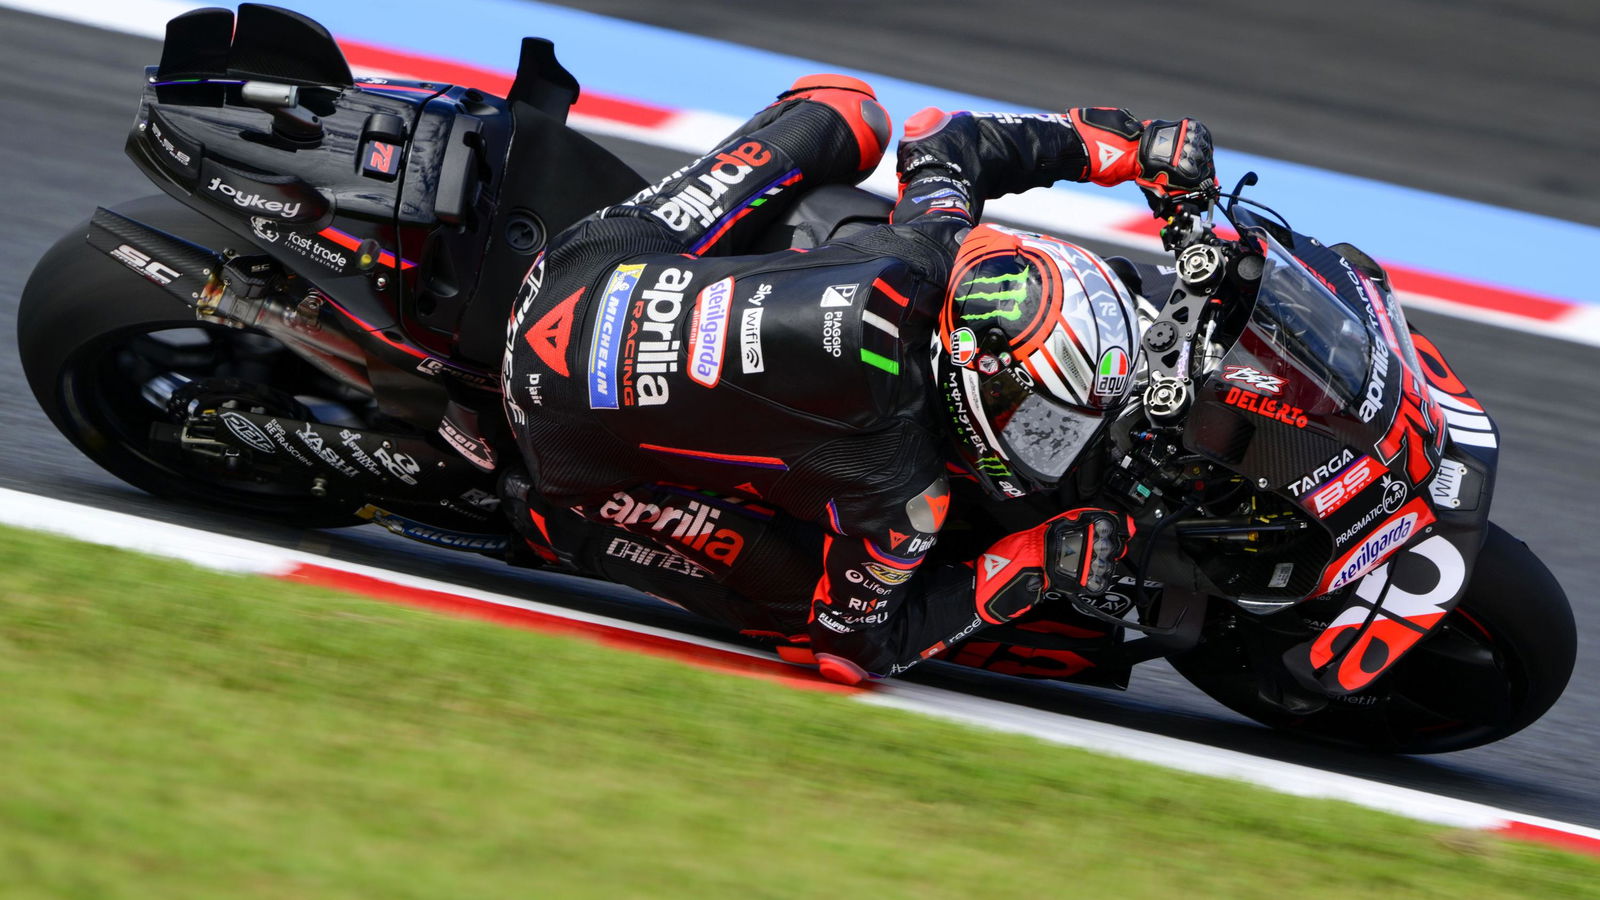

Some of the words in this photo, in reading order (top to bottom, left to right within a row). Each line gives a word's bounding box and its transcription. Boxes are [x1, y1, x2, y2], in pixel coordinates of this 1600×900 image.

[370, 141, 394, 173] 72
[207, 177, 301, 218] joykey
[651, 141, 772, 232] aprilia
[288, 231, 313, 251] fast
[313, 242, 347, 267] trade
[748, 283, 773, 306] sky
[1099, 301, 1118, 317] 72
[597, 296, 619, 395] MICHELIN
[622, 300, 645, 407] RACING
[635, 267, 694, 406] aprilia
[697, 282, 727, 377] sterilgarda
[822, 312, 834, 353] GROUP
[832, 311, 843, 358] PIAGGIO
[1100, 376, 1124, 394] agv
[1359, 335, 1390, 423] aprilia
[949, 372, 988, 454] MONSTER
[1288, 448, 1355, 497] TARGA
[1313, 458, 1371, 514] BS
[1385, 488, 1405, 508] PLAY
[599, 491, 745, 567] aprilia
[1336, 504, 1383, 547] PRAGMATIC
